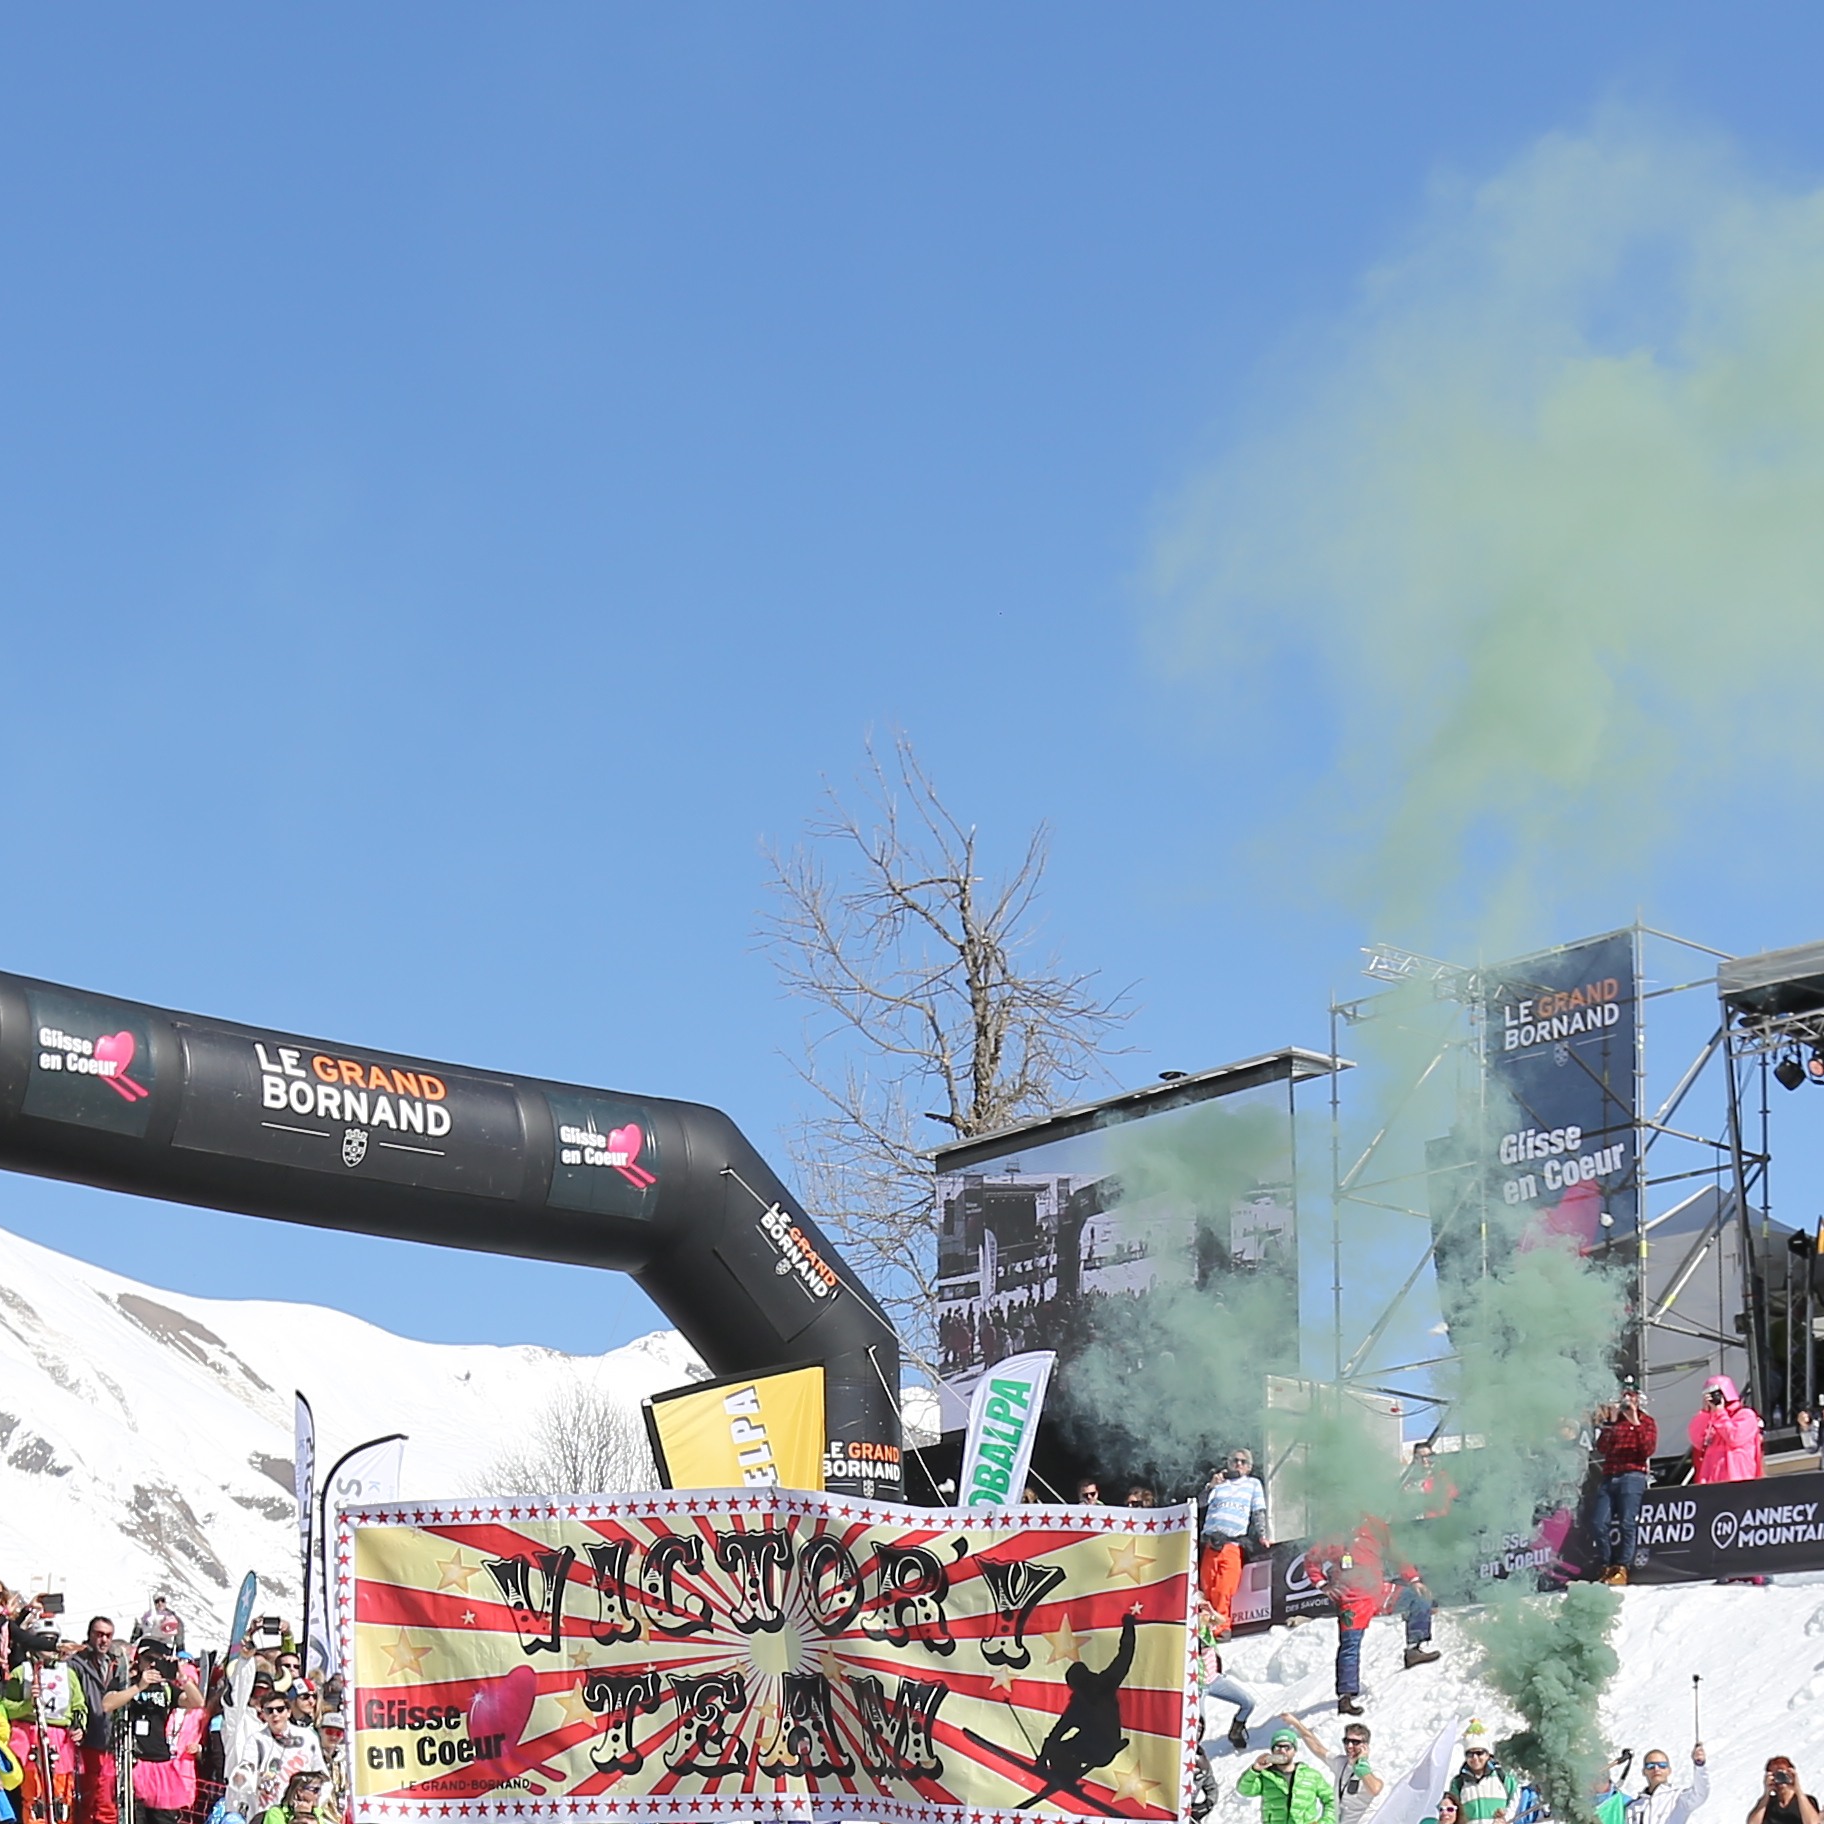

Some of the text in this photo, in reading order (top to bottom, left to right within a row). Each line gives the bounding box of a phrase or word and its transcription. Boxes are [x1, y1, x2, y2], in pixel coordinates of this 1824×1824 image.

[1504, 978, 1619, 1027] LE GRAND
[39, 1027, 93, 1053] Glisse
[1504, 1002, 1620, 1051] BORNAND
[39, 1052, 117, 1077] en Coeur
[254, 1043, 447, 1101] LE GRAND
[262, 1075, 452, 1137] BORNAND
[560, 1125, 608, 1149] Glisse
[1500, 1125, 1582, 1166] Glisse
[560, 1145, 629, 1166] en Coeur
[1503, 1143, 1625, 1205] en Coeur
[760, 1212, 828, 1298] BORNAND
[770, 1202, 838, 1288] LE GRAND
[848, 1442, 900, 1463] GRAND
[1637, 1501, 1697, 1523] RAND
[1739, 1503, 1819, 1526] ANNECY
[1505, 1546, 1552, 1573] Coeur
[1232, 1606, 1270, 1623] PRIAMS
[365, 1698, 461, 1733] Glisse
[583, 1671, 951, 1782] TEAM
[368, 1732, 506, 1770] en Coeur
[401, 1778, 531, 1791] LE GRAND-BORNAND
